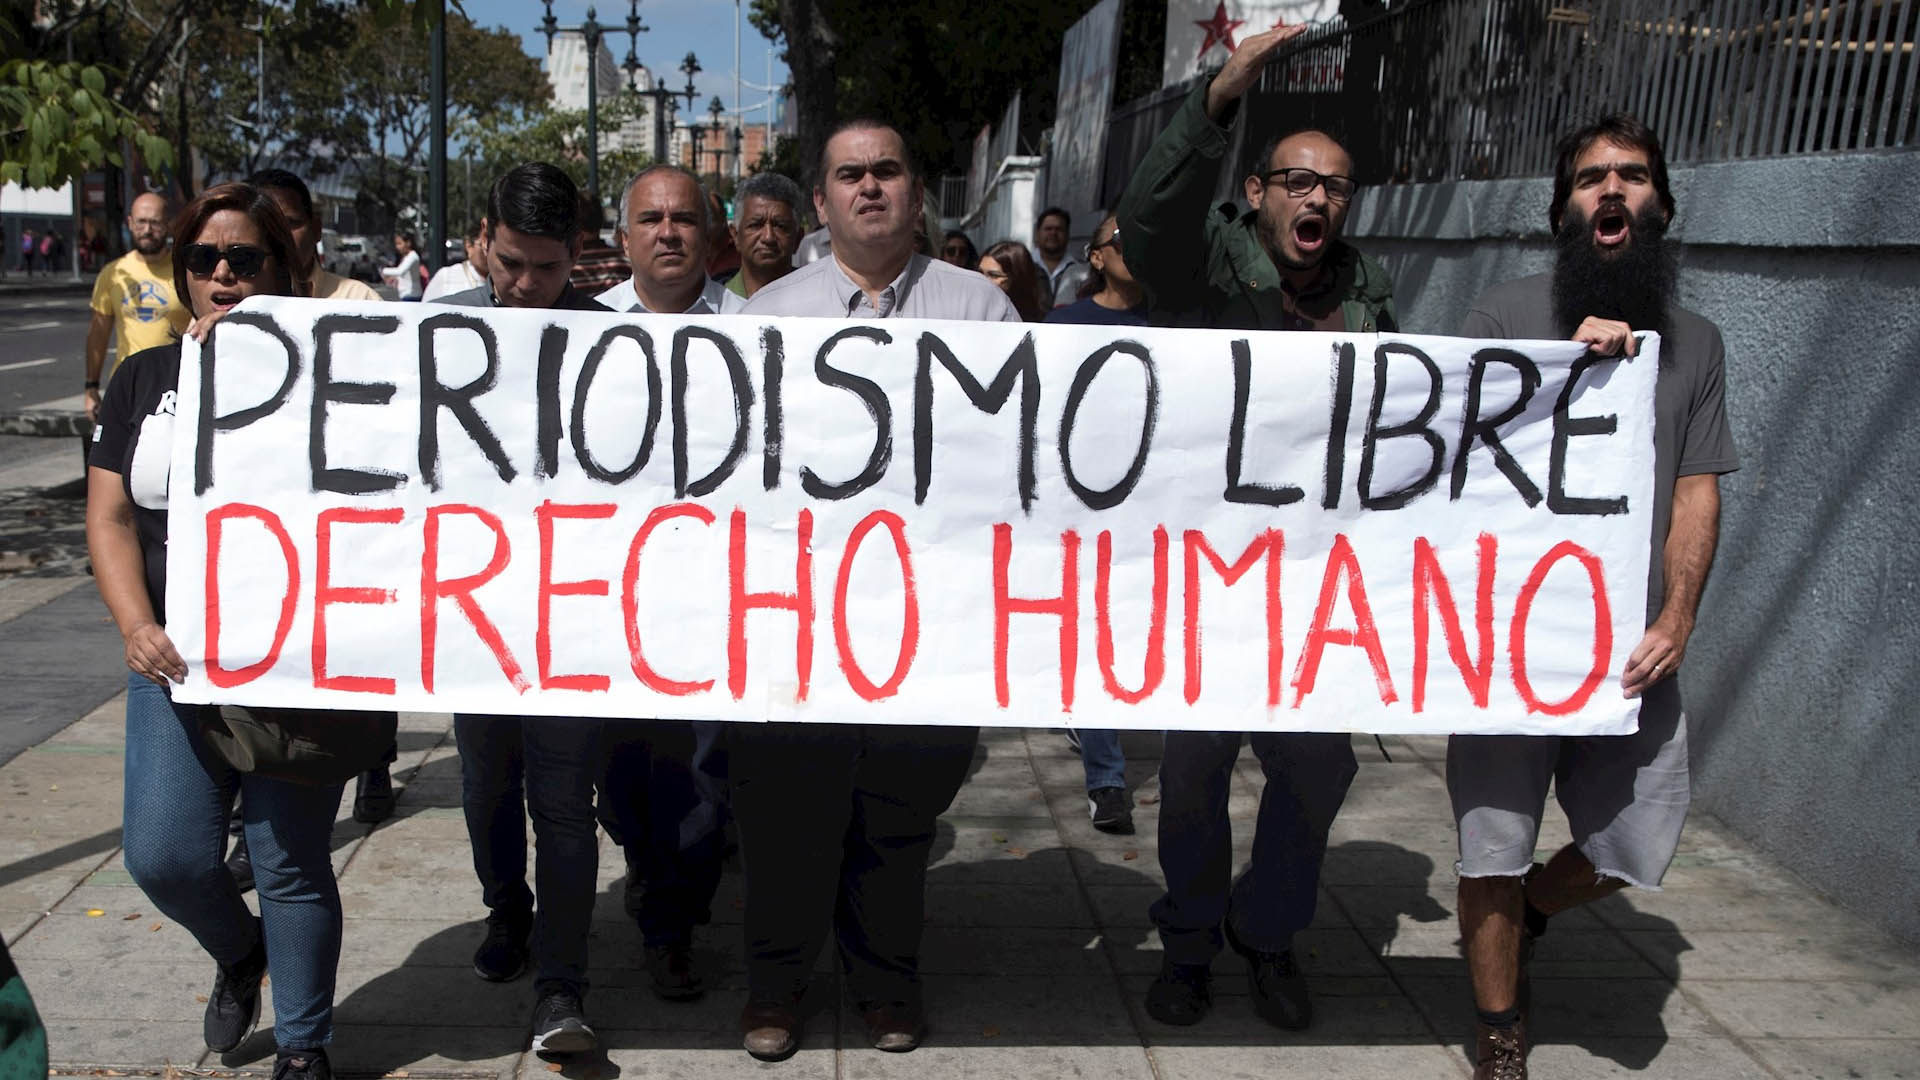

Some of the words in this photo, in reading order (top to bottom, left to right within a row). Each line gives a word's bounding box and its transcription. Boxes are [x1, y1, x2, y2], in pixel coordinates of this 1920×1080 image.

[195, 311, 1160, 514] PERIODISMO
[1223, 335, 1645, 517] LIBRE
[204, 499, 921, 703] DERECHO
[992, 522, 1614, 719] HUMANO
